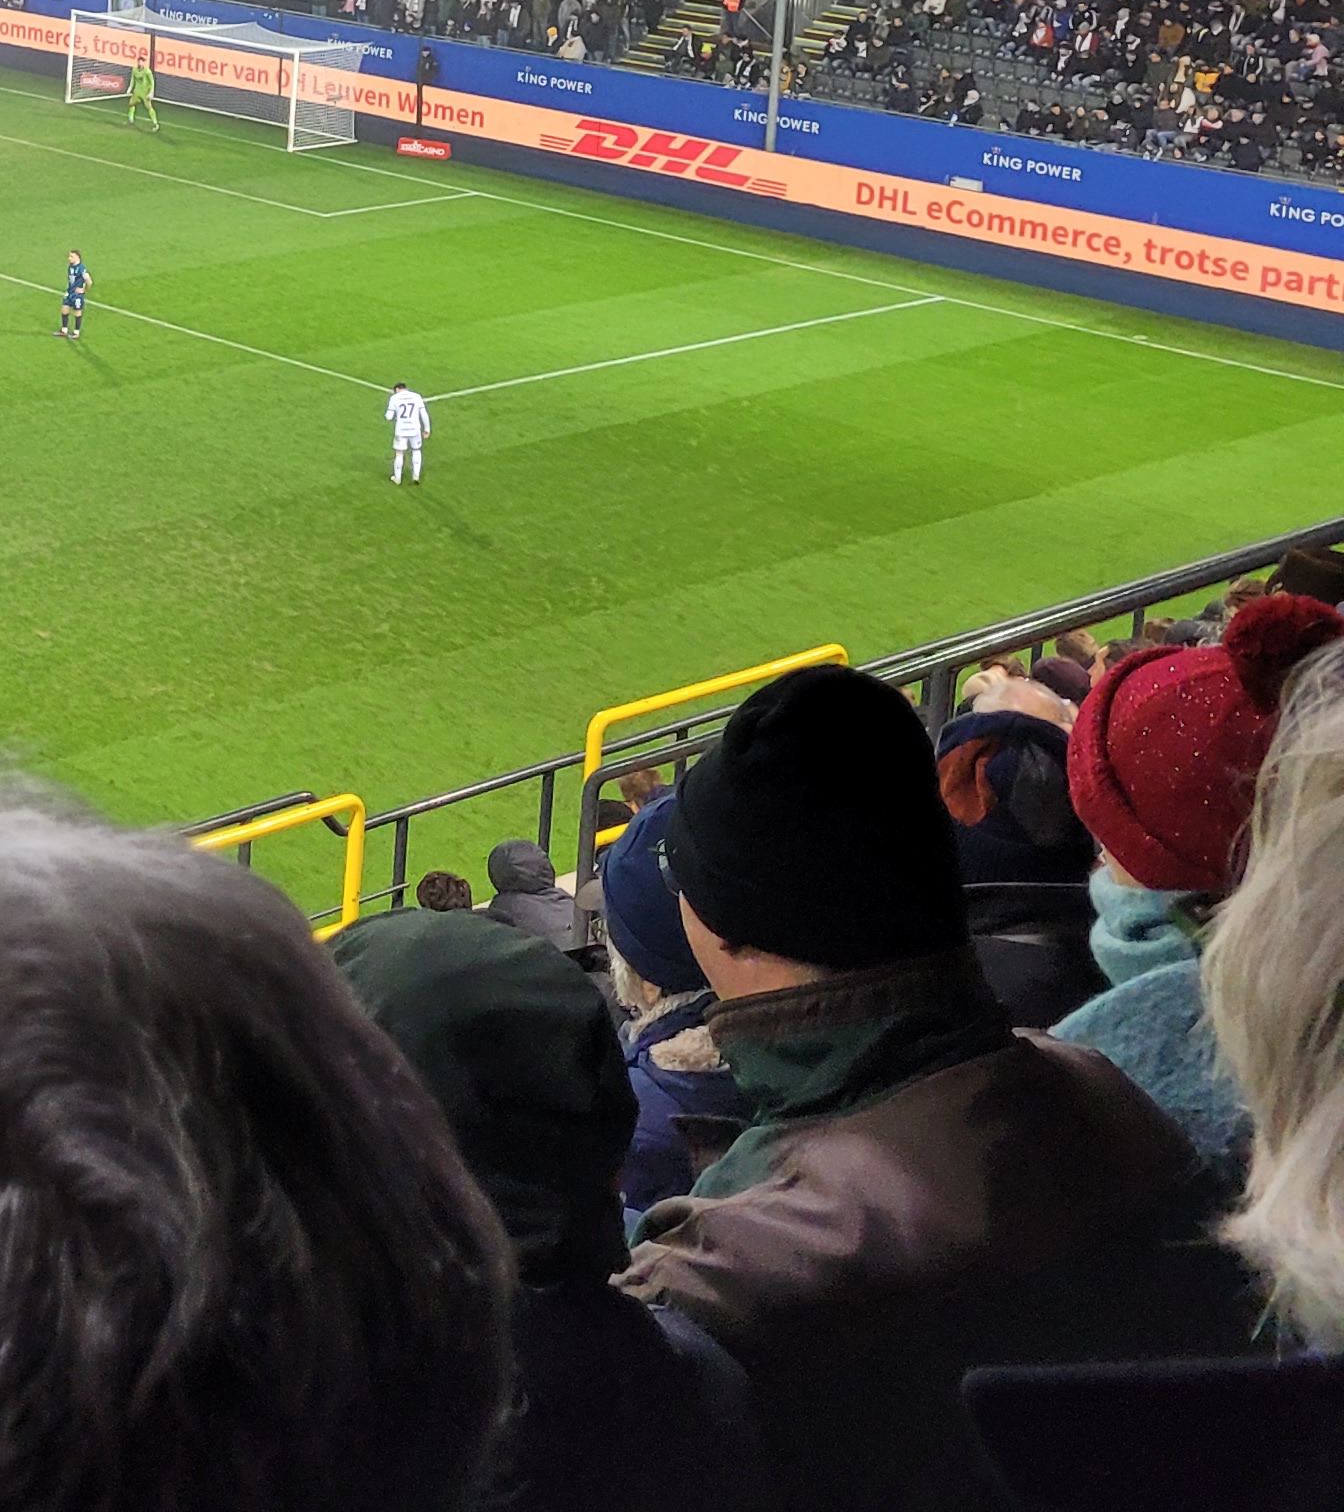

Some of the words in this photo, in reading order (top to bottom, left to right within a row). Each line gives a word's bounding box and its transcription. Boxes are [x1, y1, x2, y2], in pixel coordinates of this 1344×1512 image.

[160, 9, 184, 22] KING
[186, 13, 219, 26] POWER
[93, 35, 148, 59] trotse
[155, 50, 229, 76] partner
[233, 65, 269, 85] van
[398, 91, 485, 128] Women
[517, 71, 548, 87] KING
[551, 77, 593, 95] POWER
[734, 108, 768, 124] KING
[570, 119, 753, 187] DHL
[983, 152, 1022, 171] KING
[1027, 160, 1081, 182] POWER
[1270, 202, 1315, 222] KING
[855, 181, 917, 216] DHL
[926, 198, 1132, 264] eCommerce,
[1144, 238, 1250, 281] trotse
[1260, 264, 1344, 302] part
[399, 402, 415, 419] 27
